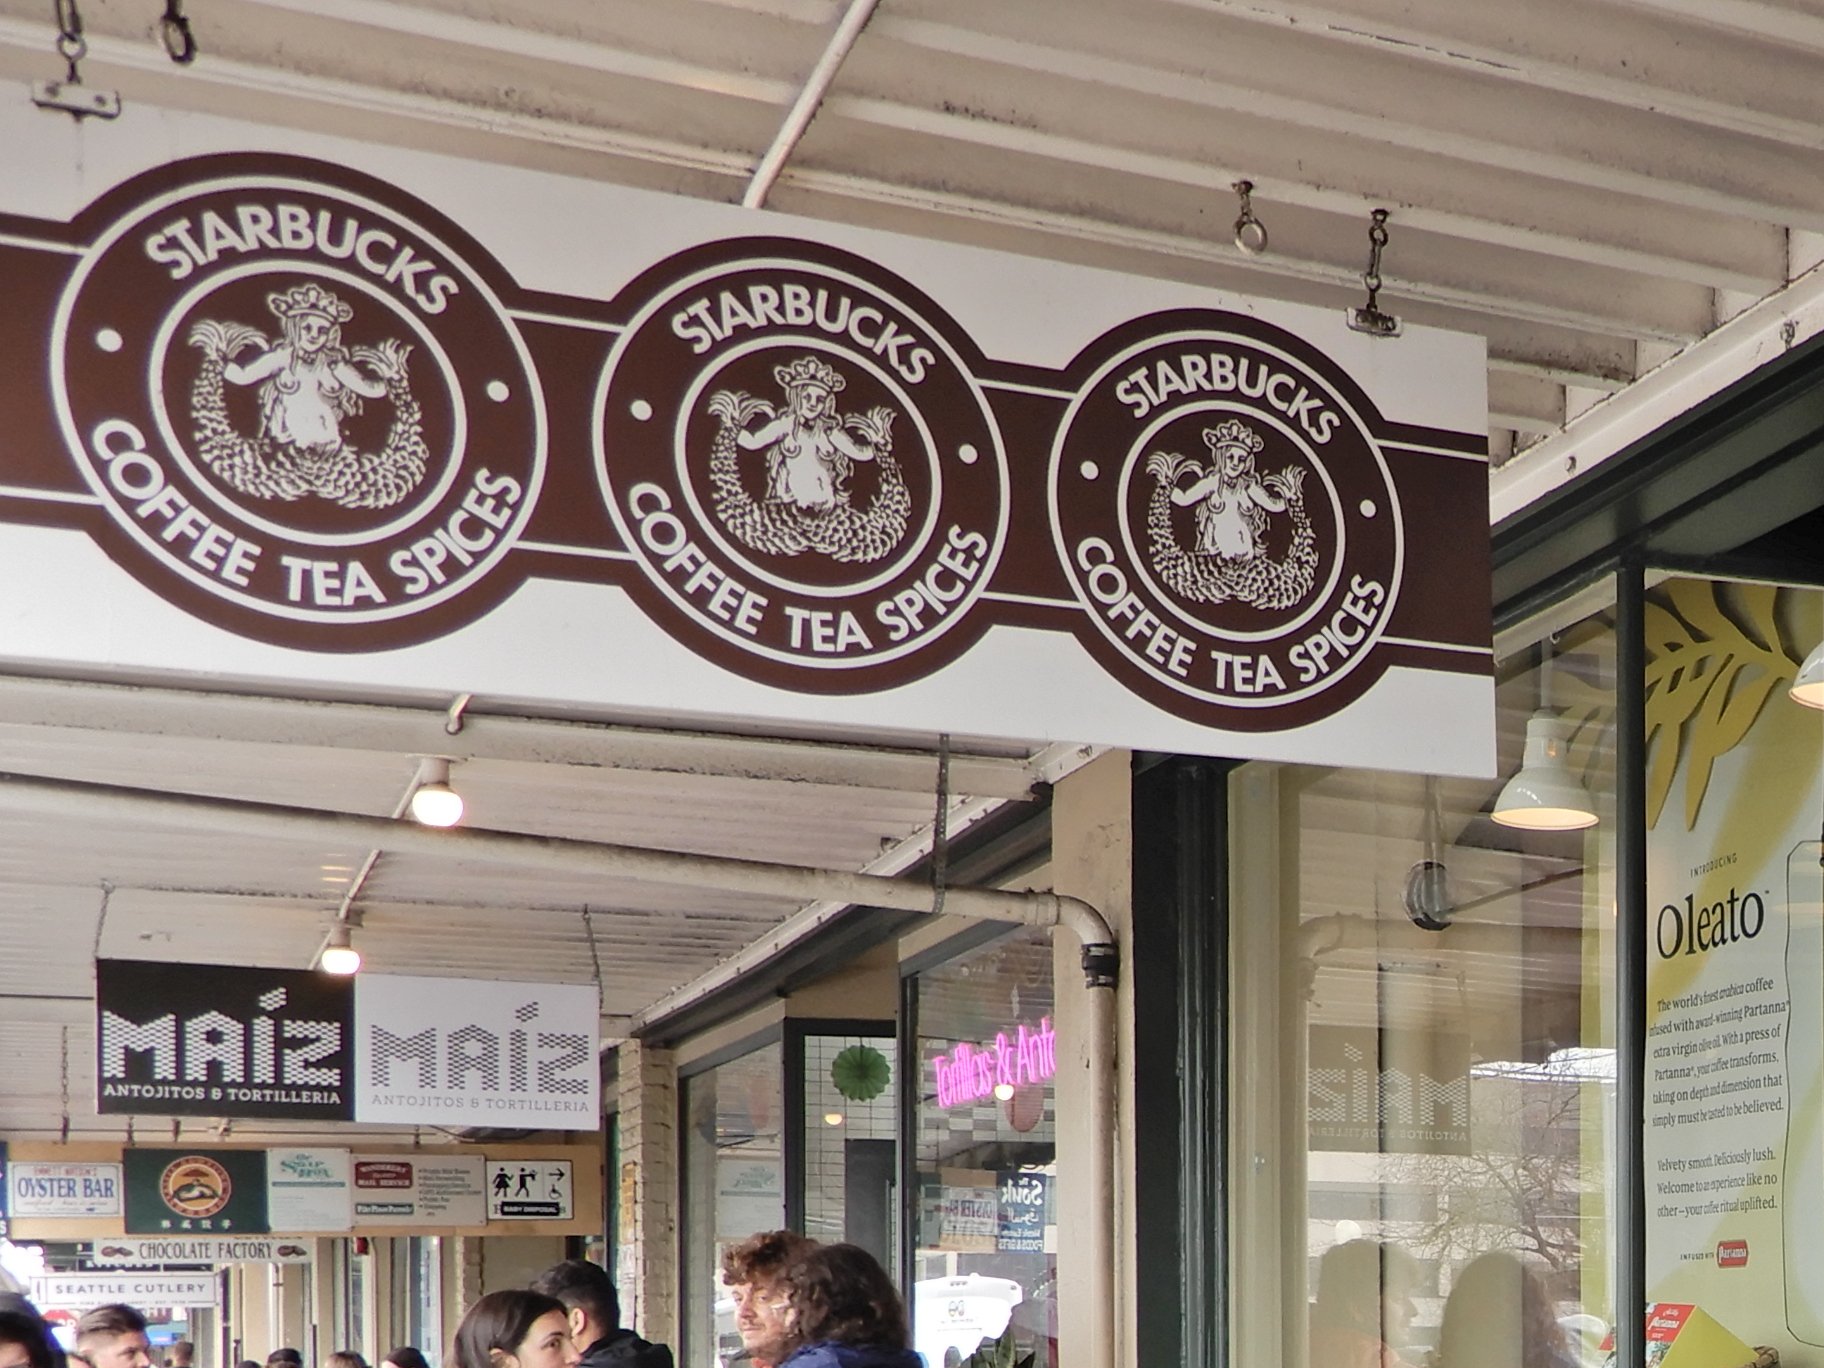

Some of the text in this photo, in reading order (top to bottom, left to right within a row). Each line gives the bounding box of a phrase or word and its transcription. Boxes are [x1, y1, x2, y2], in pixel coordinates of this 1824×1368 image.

[145, 204, 460, 315] STARBUCKS
[672, 284, 936, 385] STARBUCKS
[1115, 353, 1342, 445] STARBUCKS
[92, 419, 523, 605] COFFEE TEA SPICES
[628, 482, 989, 653] COFFEE TEA SPICES
[1077, 537, 1385, 693] COFFEE TEA SPICES
[1690, 852, 1738, 878] INTRODUCING
[1657, 999, 1671, 1013] The
[1745, 978, 1774, 995] coffee
[103, 986, 341, 1087] MAÍZ
[1673, 1018, 1694, 1033] with
[371, 1001, 589, 1095] MAÍZ
[1672, 1040, 1697, 1057] virgin
[1745, 1028, 1770, 1044] press
[1771, 1024, 1782, 1038] of
[1729, 1052, 1779, 1068] transforms,
[933, 1042, 995, 1108] Tortillas
[1653, 1090, 1675, 1105] taking
[1677, 1090, 1688, 1101] on
[1721, 1077, 1761, 1094] dimension
[1763, 1074, 1783, 1088] that
[103, 1084, 341, 1105] ANTOJITOS & TORTILLERIA
[371, 1094, 464, 1109] ANTOJITOS
[485, 1098, 589, 1113] TORTILLERIA
[1677, 1111, 1700, 1124] must
[1743, 1097, 1784, 1114] believed.
[1657, 1158, 1687, 1173] Velvety
[1752, 1147, 1776, 1162] lush.
[18, 1177, 114, 1198] OYSTER BAR
[1657, 1181, 1695, 1194] Welcome
[1746, 1172, 1763, 1186] like
[1763, 1174, 1778, 1185] no
[1740, 1195, 1778, 1213] uplifted.
[139, 1241, 274, 1260] CHOCOLATE FACTORY
[55, 1282, 207, 1295] SEATTLE CUTLERY
